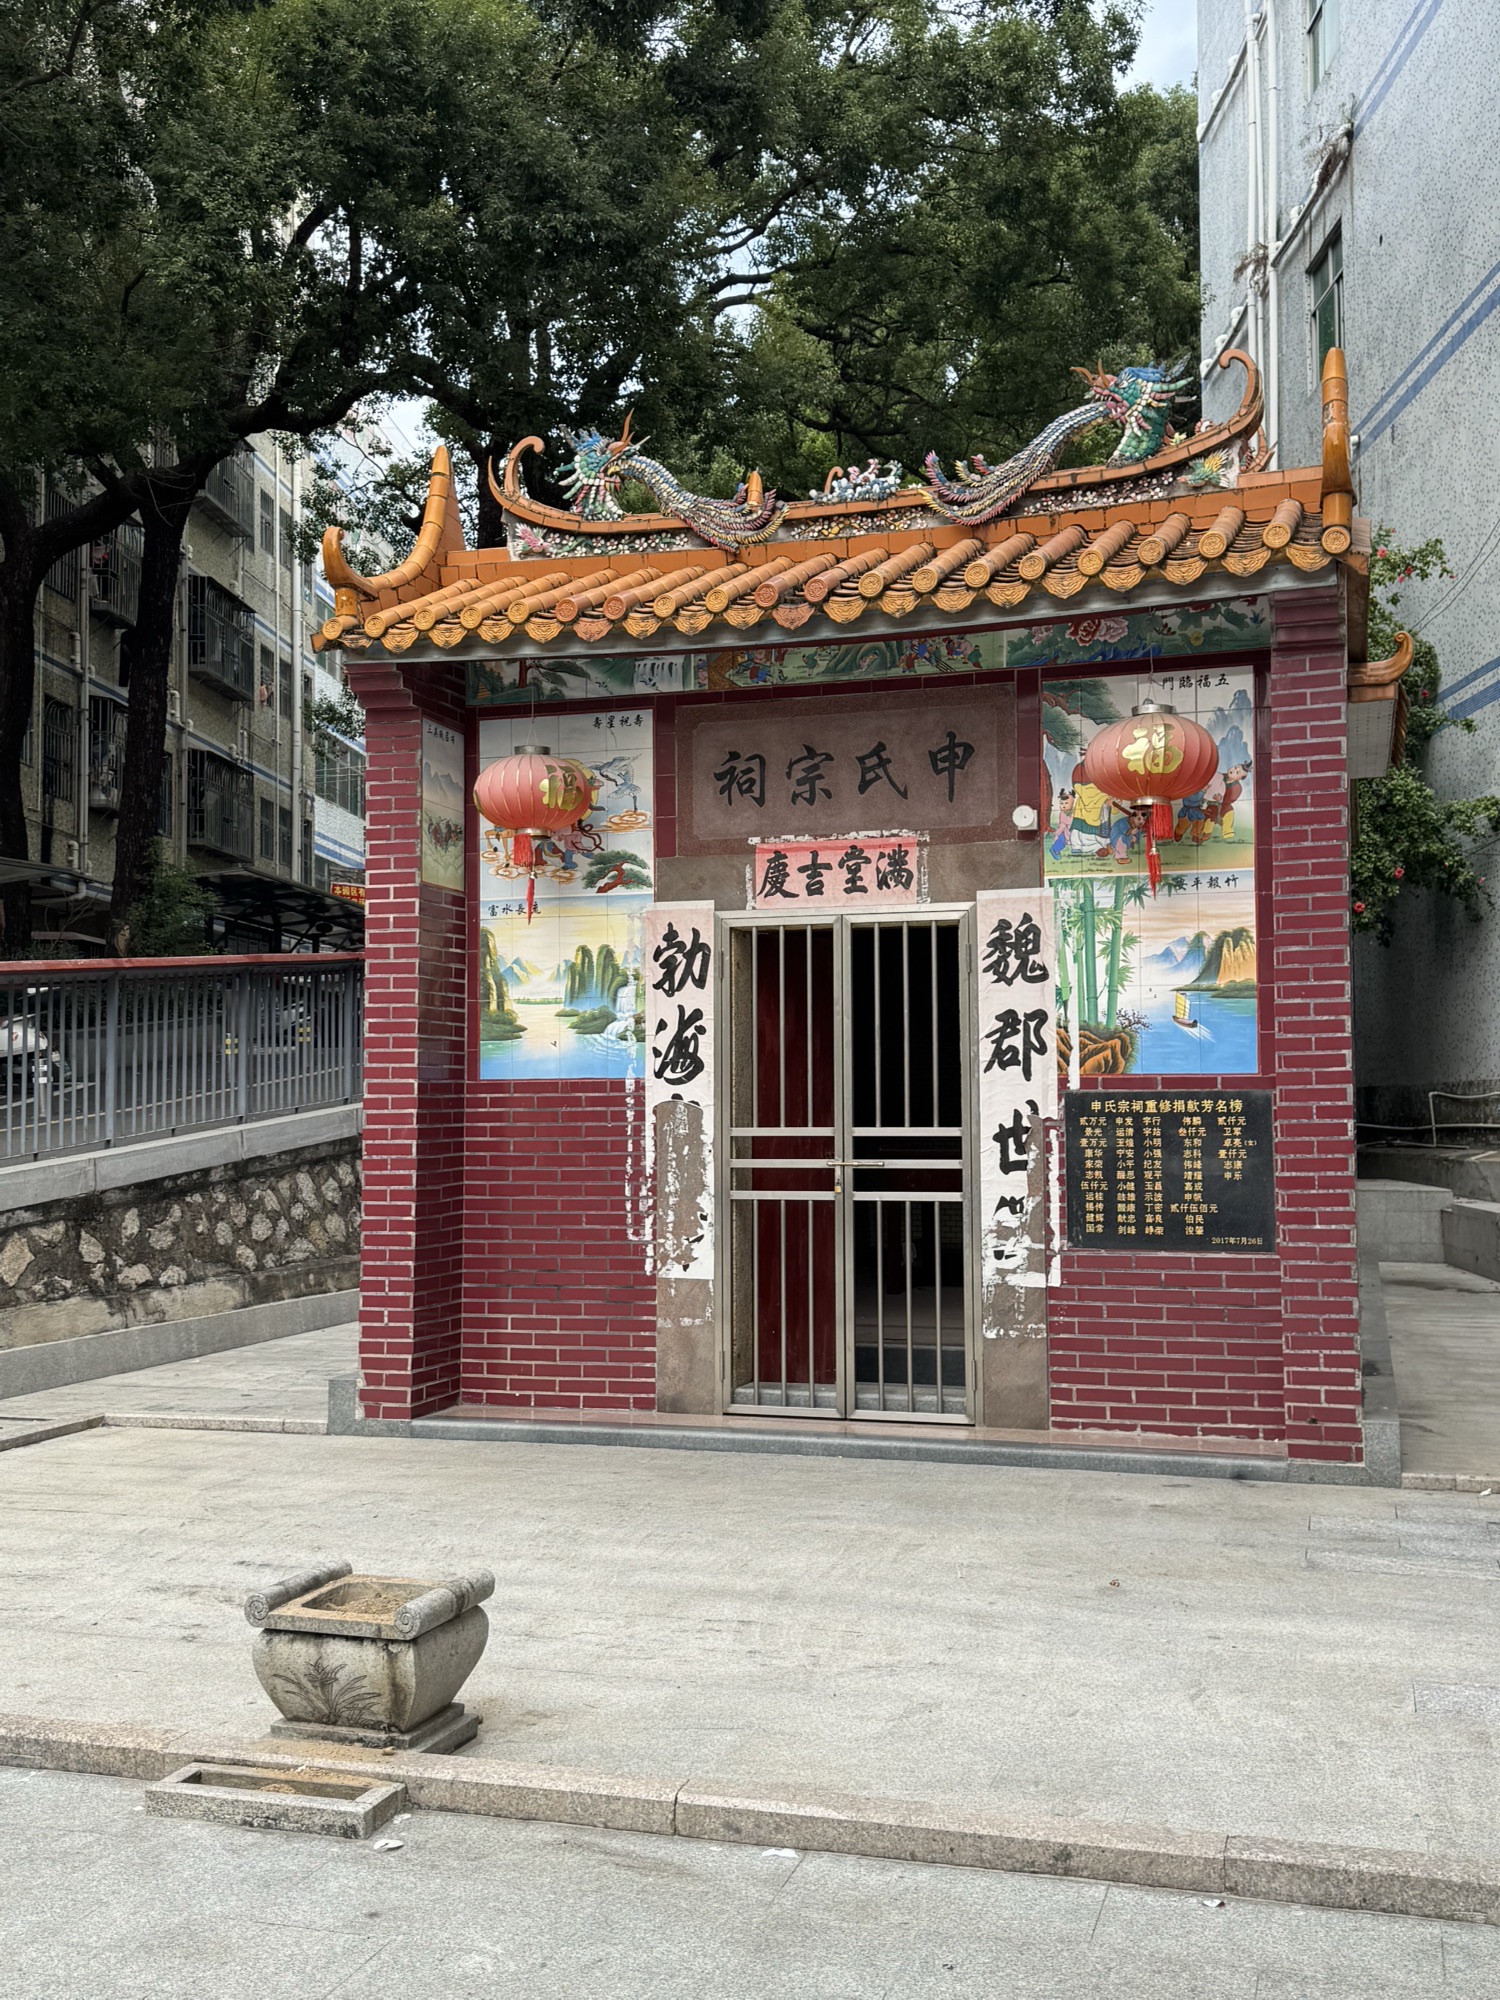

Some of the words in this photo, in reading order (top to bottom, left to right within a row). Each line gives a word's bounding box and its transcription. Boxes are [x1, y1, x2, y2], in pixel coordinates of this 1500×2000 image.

[1162, 673, 1230, 690] 五福臨門
[1122, 723, 1184, 775] 福
[713, 731, 976, 808] 申氏宗祠
[1174, 875, 1239, 892] 竹報平安
[982, 912, 1050, 1260] 魏郡世
[1223, 1127, 1242, 1137] 卫军
[1143, 1138, 1162, 1148] 小明
[1116, 1160, 1135, 1170] 小平
[1211, 1237, 1263, 1245] 2017年7月26日
